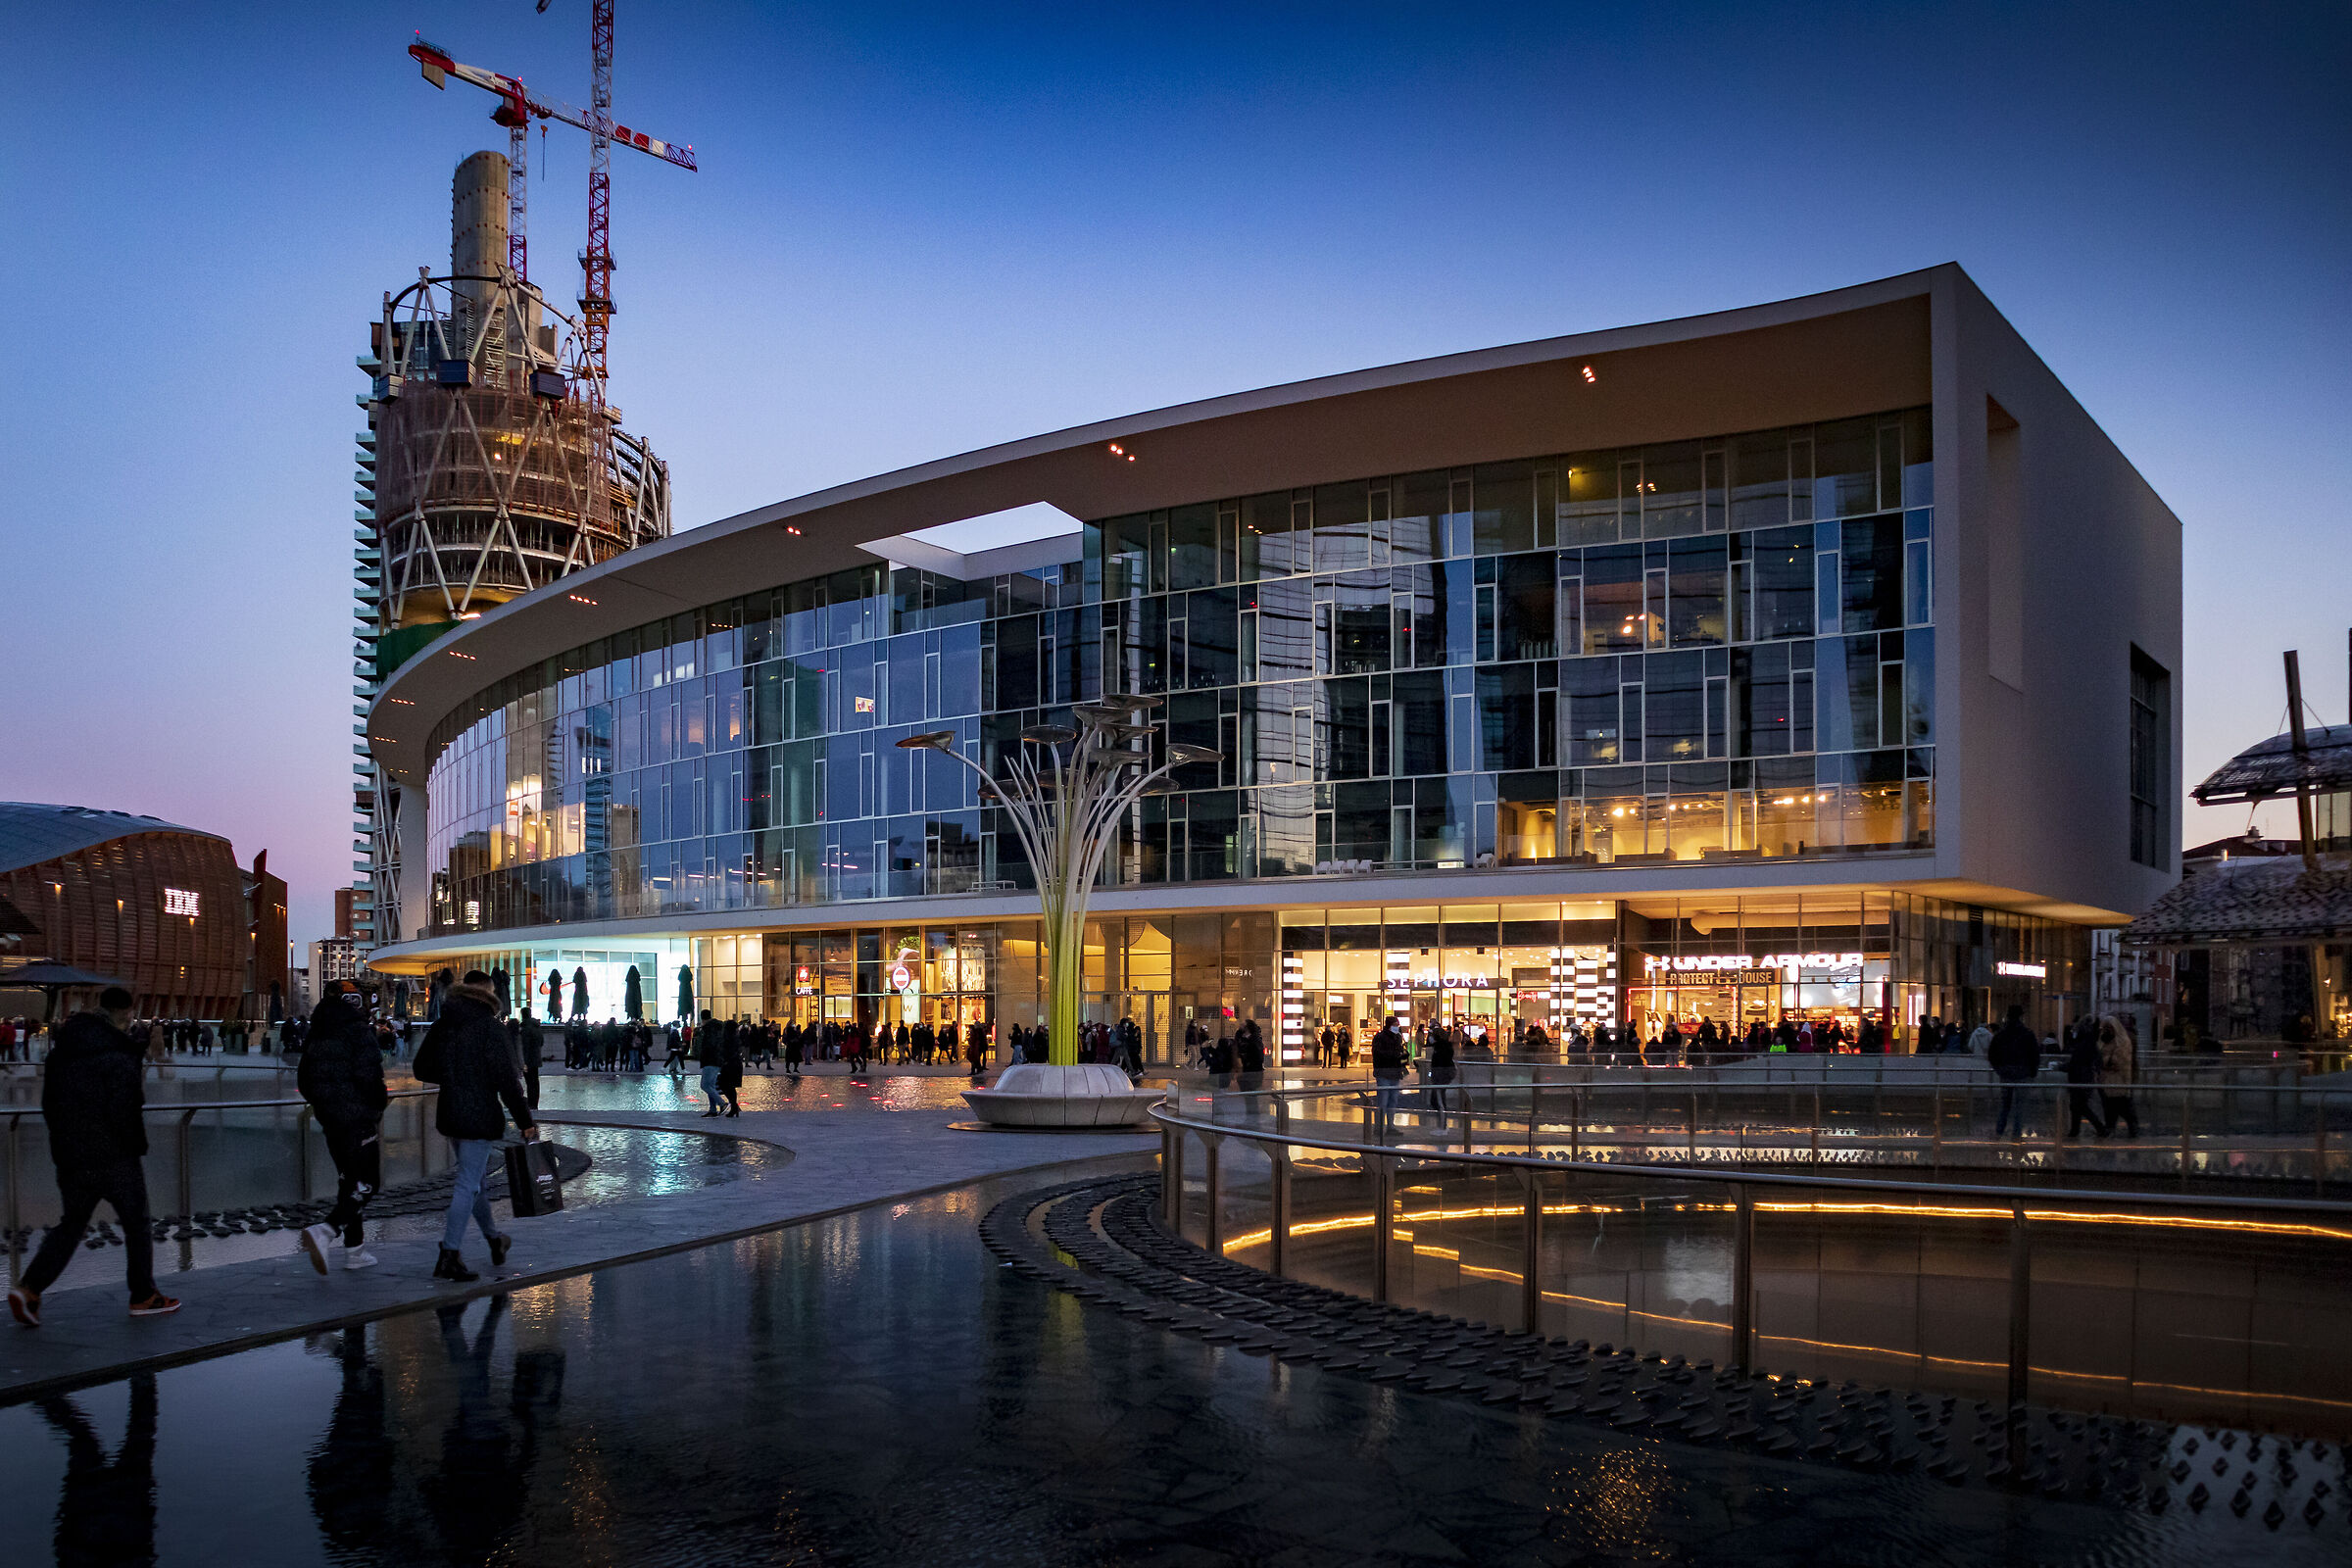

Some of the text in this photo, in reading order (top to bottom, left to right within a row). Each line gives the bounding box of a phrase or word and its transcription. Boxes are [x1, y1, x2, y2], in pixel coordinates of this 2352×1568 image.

[165, 888, 199, 916] IBM
[1673, 954, 1864, 970] UNDER ARMOUR
[1386, 971, 1489, 988] SEPHORA
